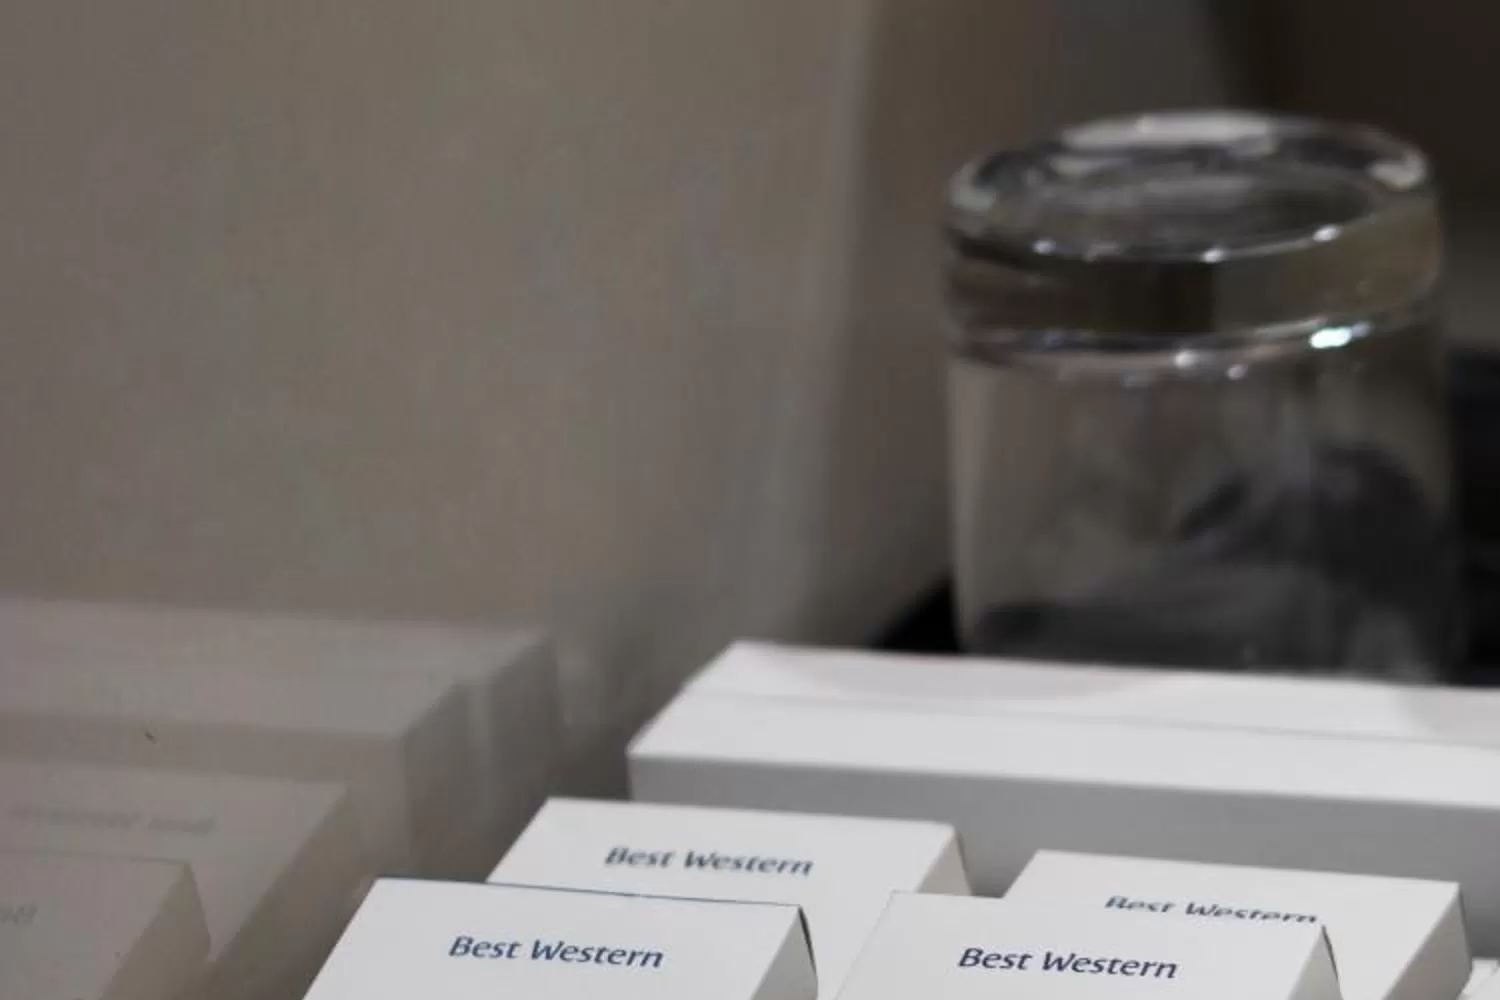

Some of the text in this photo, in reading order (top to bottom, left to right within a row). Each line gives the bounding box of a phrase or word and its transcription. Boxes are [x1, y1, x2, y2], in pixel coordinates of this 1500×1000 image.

[603, 846, 814, 877] Best Western
[448, 935, 664, 969] Best Western
[957, 947, 1179, 980] Best Western
